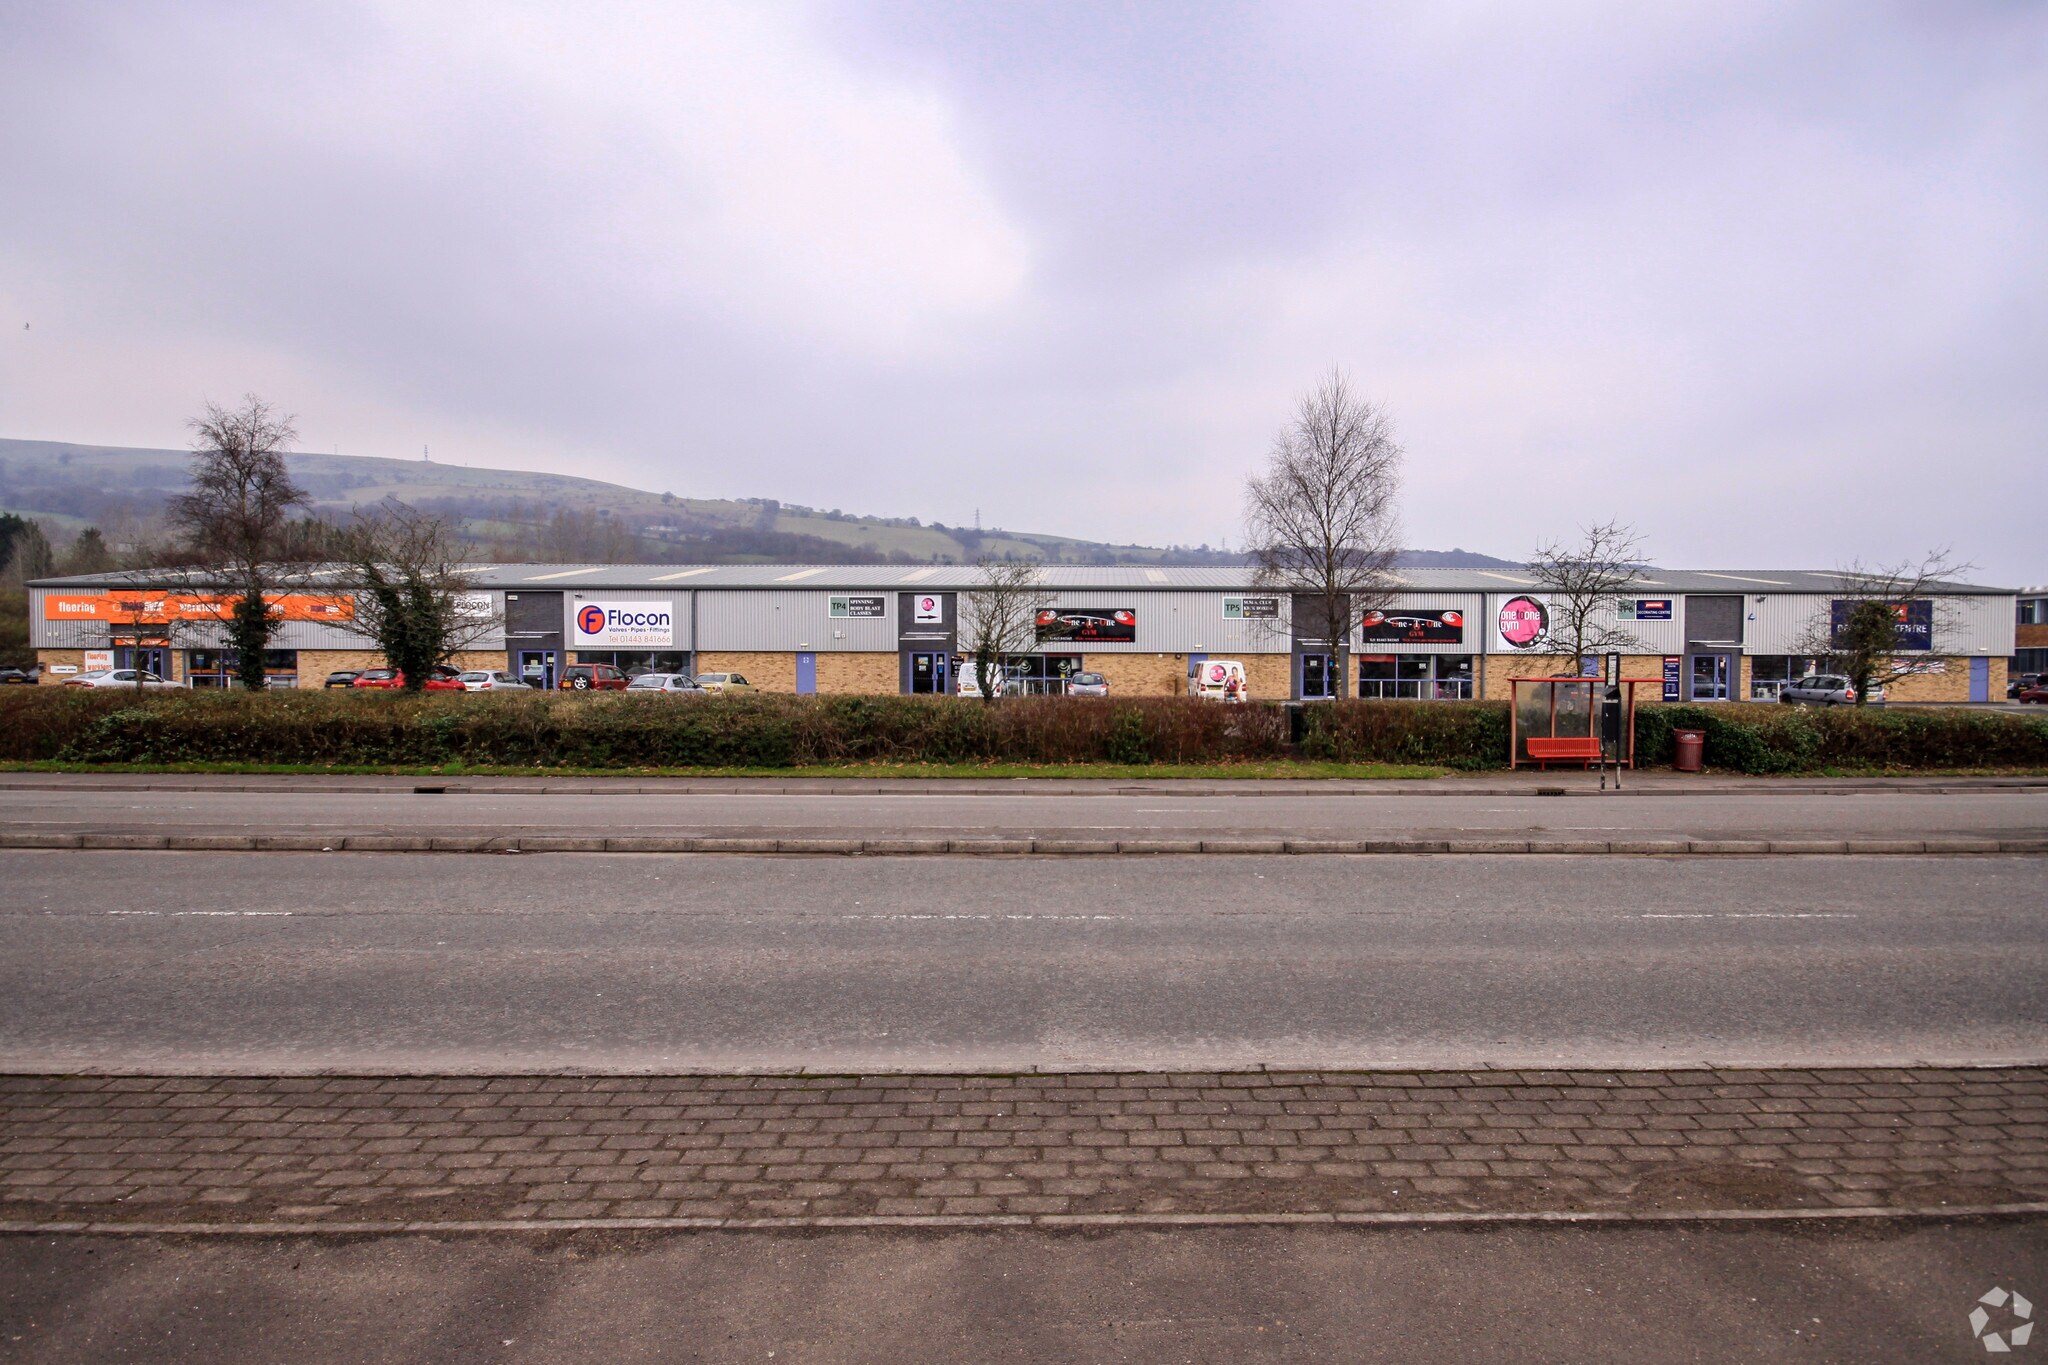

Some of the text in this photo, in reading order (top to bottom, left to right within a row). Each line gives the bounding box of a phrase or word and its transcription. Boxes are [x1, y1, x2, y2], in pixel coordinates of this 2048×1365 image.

[58, 602, 96, 613] flooring
[1619, 605, 1634, 613] TP6
[608, 609, 670, 626] Flocon
[630, 627, 646, 635] Pipes
[649, 627, 670, 635] Fittings
[1500, 621, 1519, 632] gym
[608, 635, 671, 643] Tel 01443 841666
